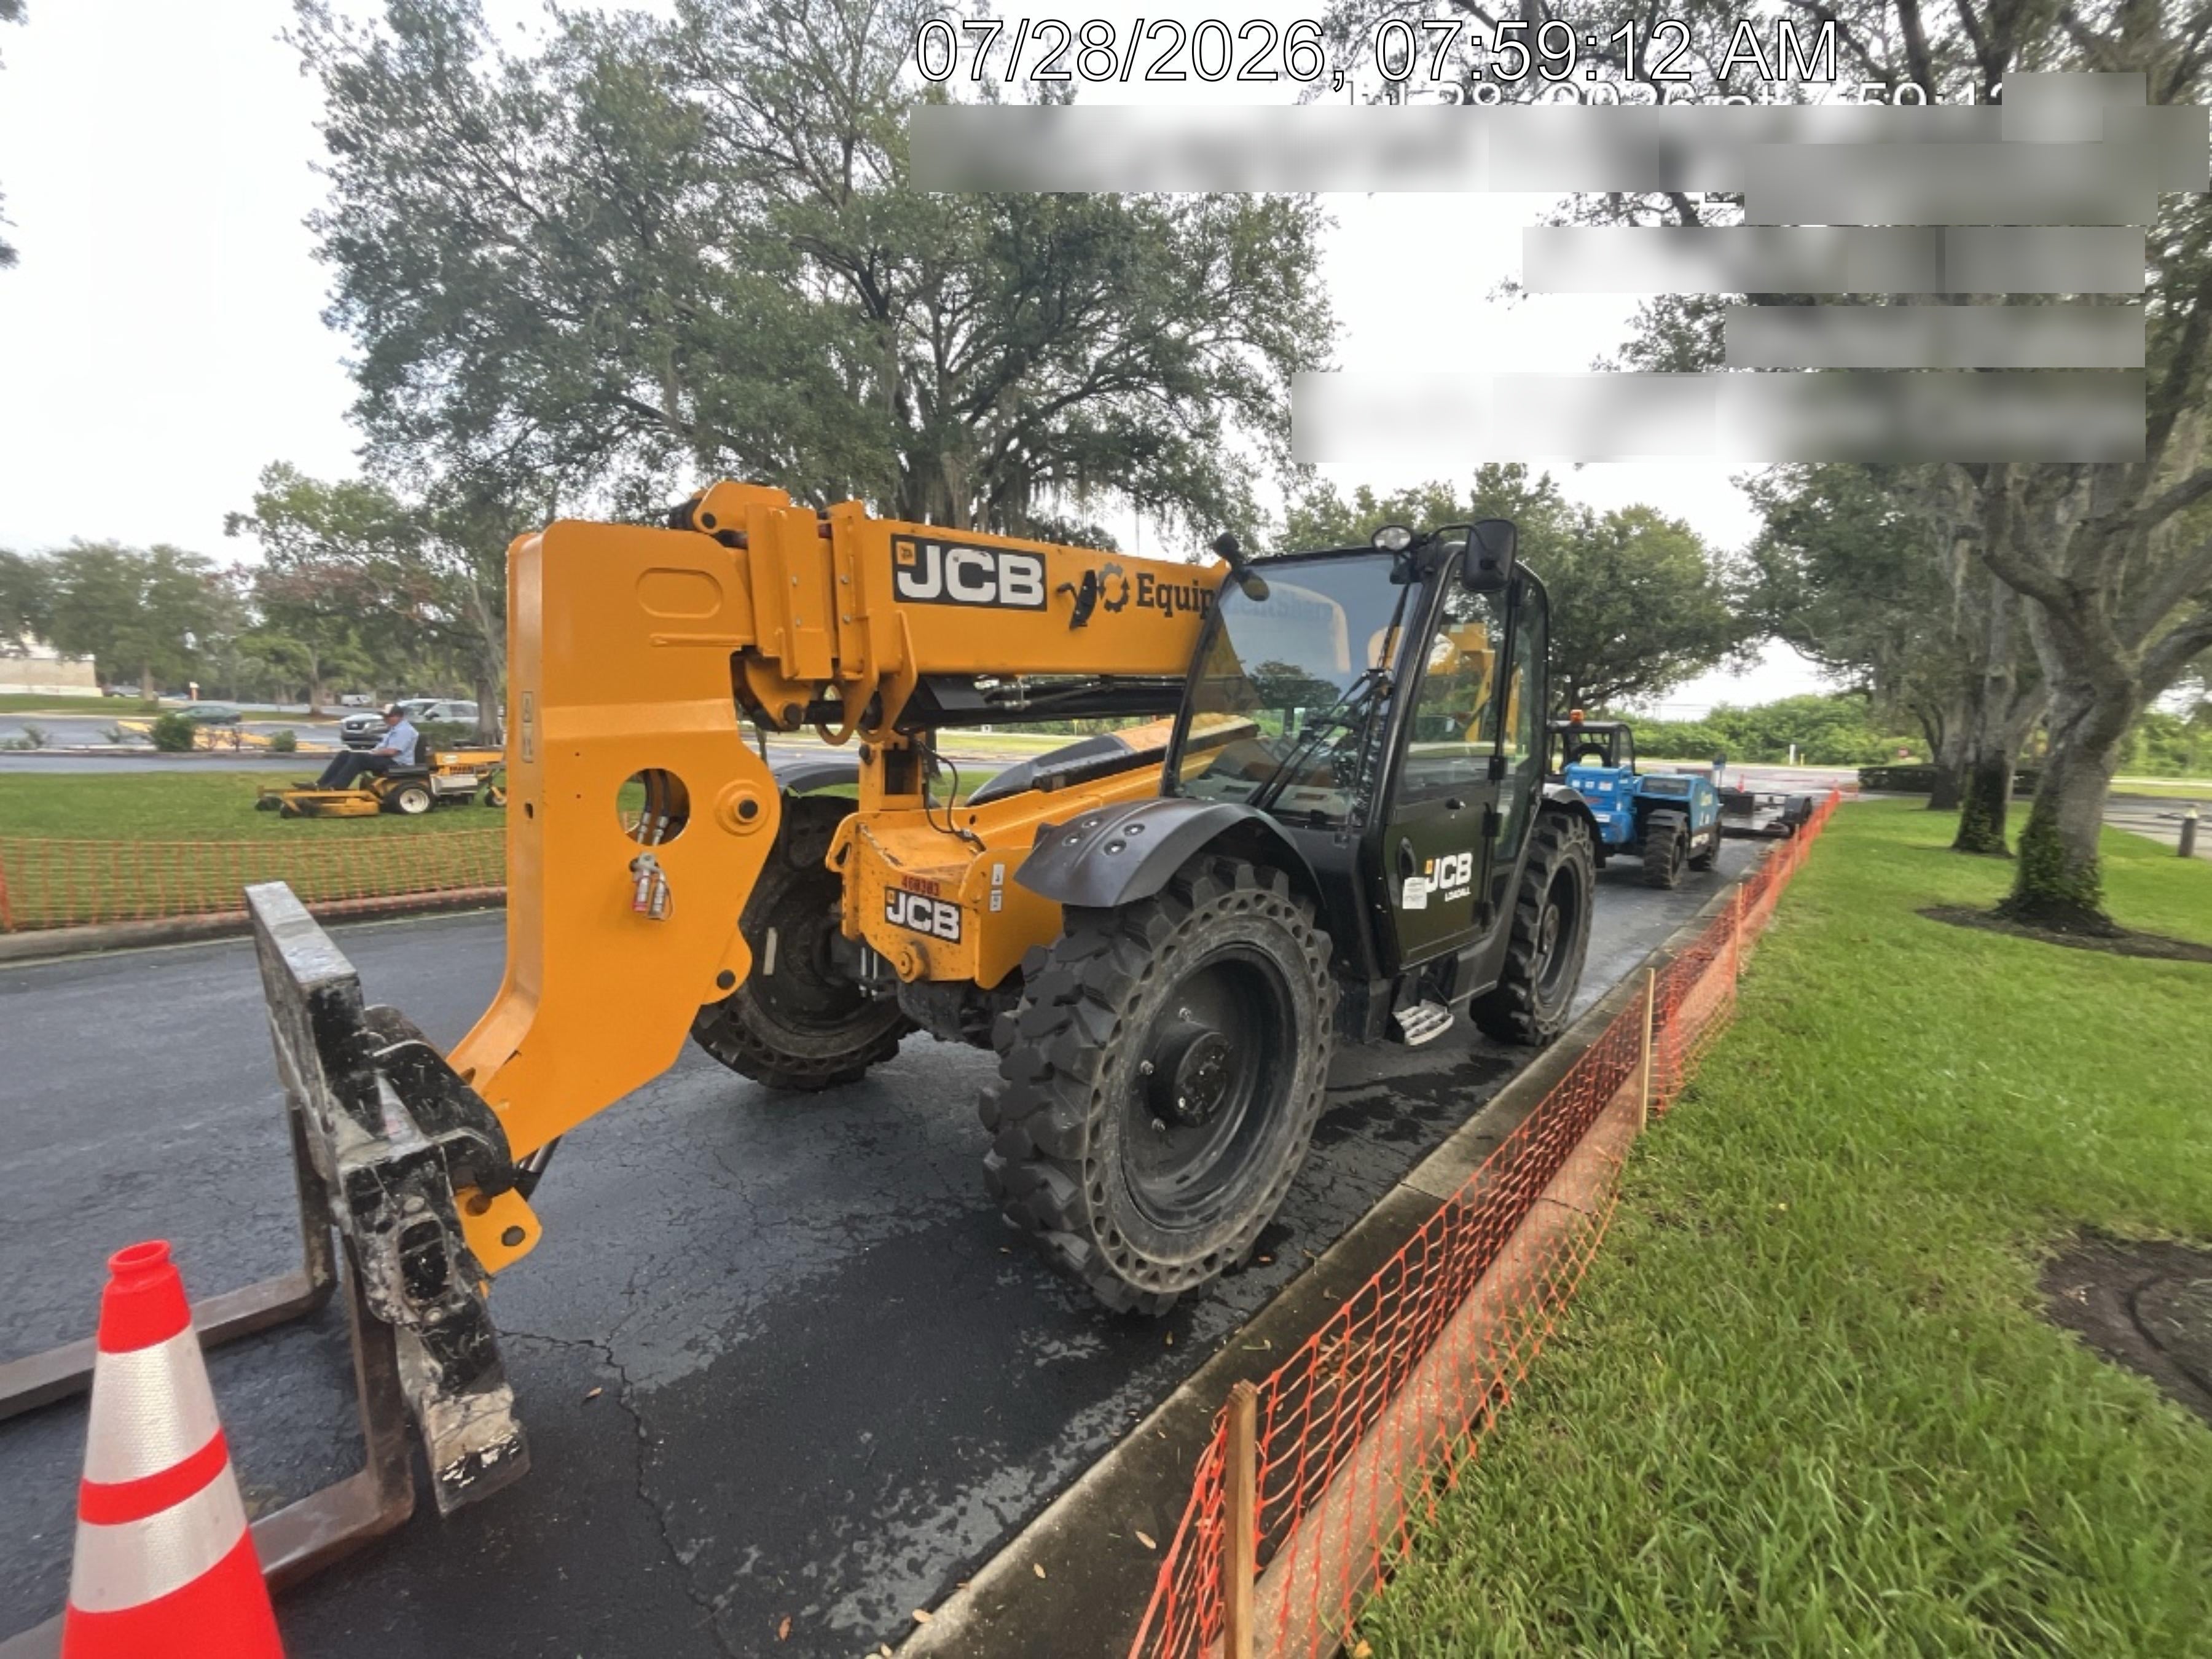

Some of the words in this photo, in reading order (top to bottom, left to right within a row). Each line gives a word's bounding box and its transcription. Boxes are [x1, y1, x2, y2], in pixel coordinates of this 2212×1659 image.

[897, 544, 1044, 606] JCB
[1425, 852, 1472, 893] JCB
[887, 891, 960, 940] JCB
